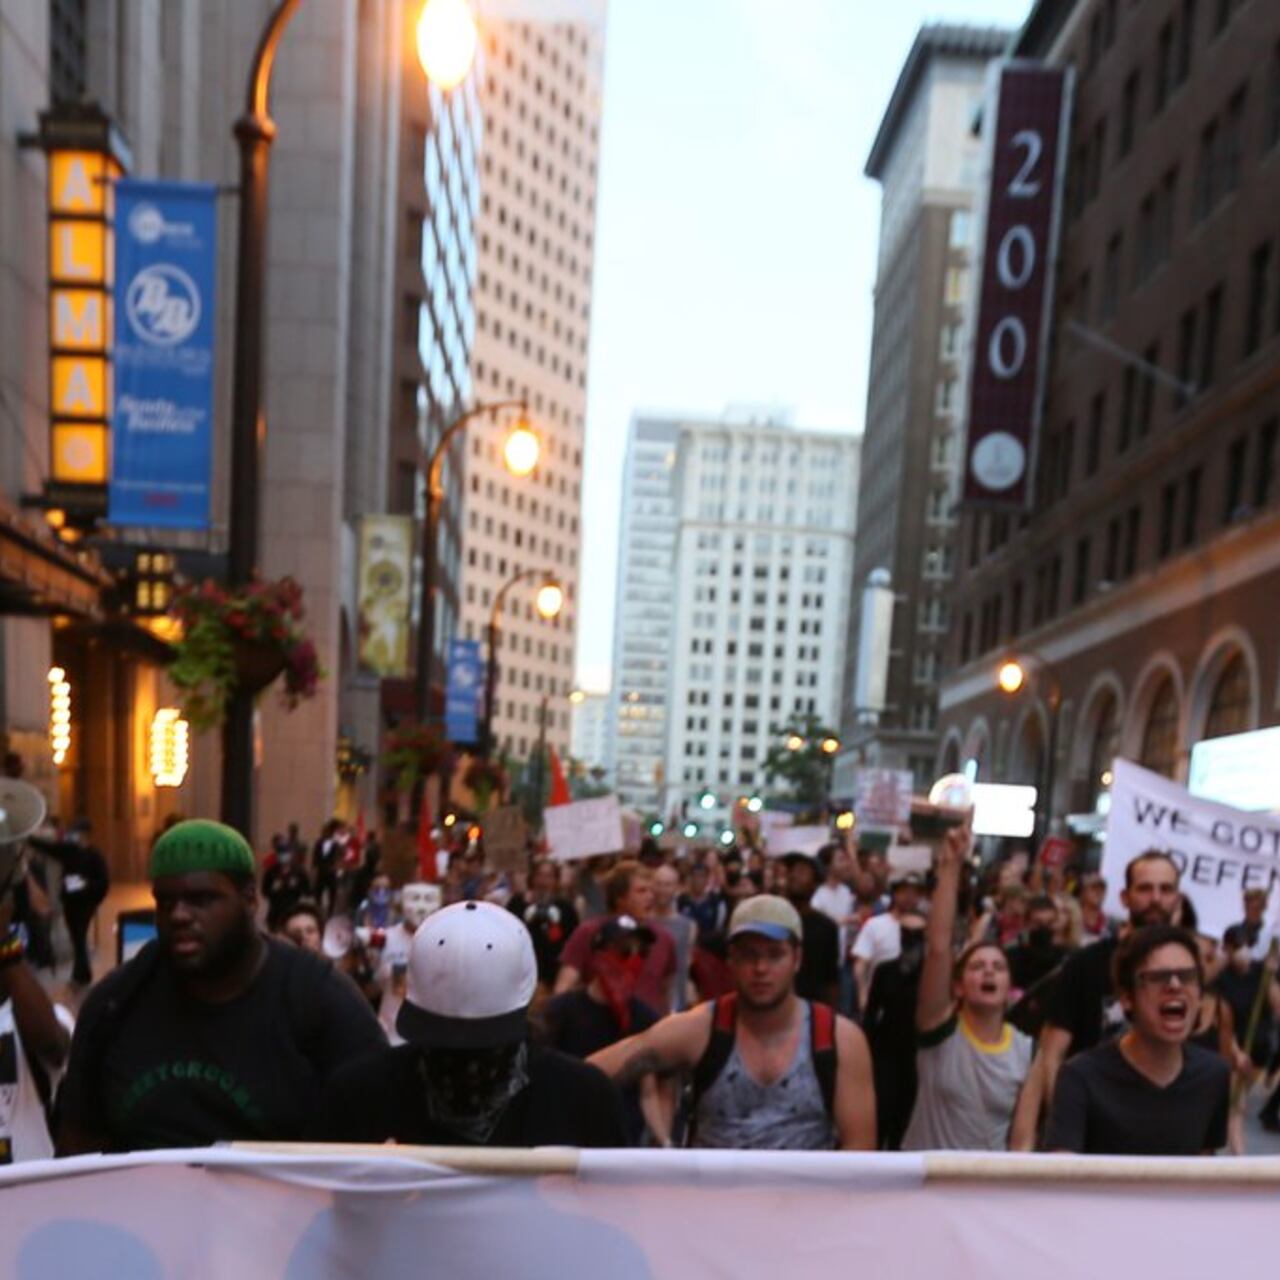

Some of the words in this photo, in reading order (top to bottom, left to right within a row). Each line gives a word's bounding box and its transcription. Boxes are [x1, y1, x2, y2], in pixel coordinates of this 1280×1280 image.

[55, 159, 100, 412] ALMA
[987, 128, 1043, 381] 200
[1133, 796, 1192, 835] WE
